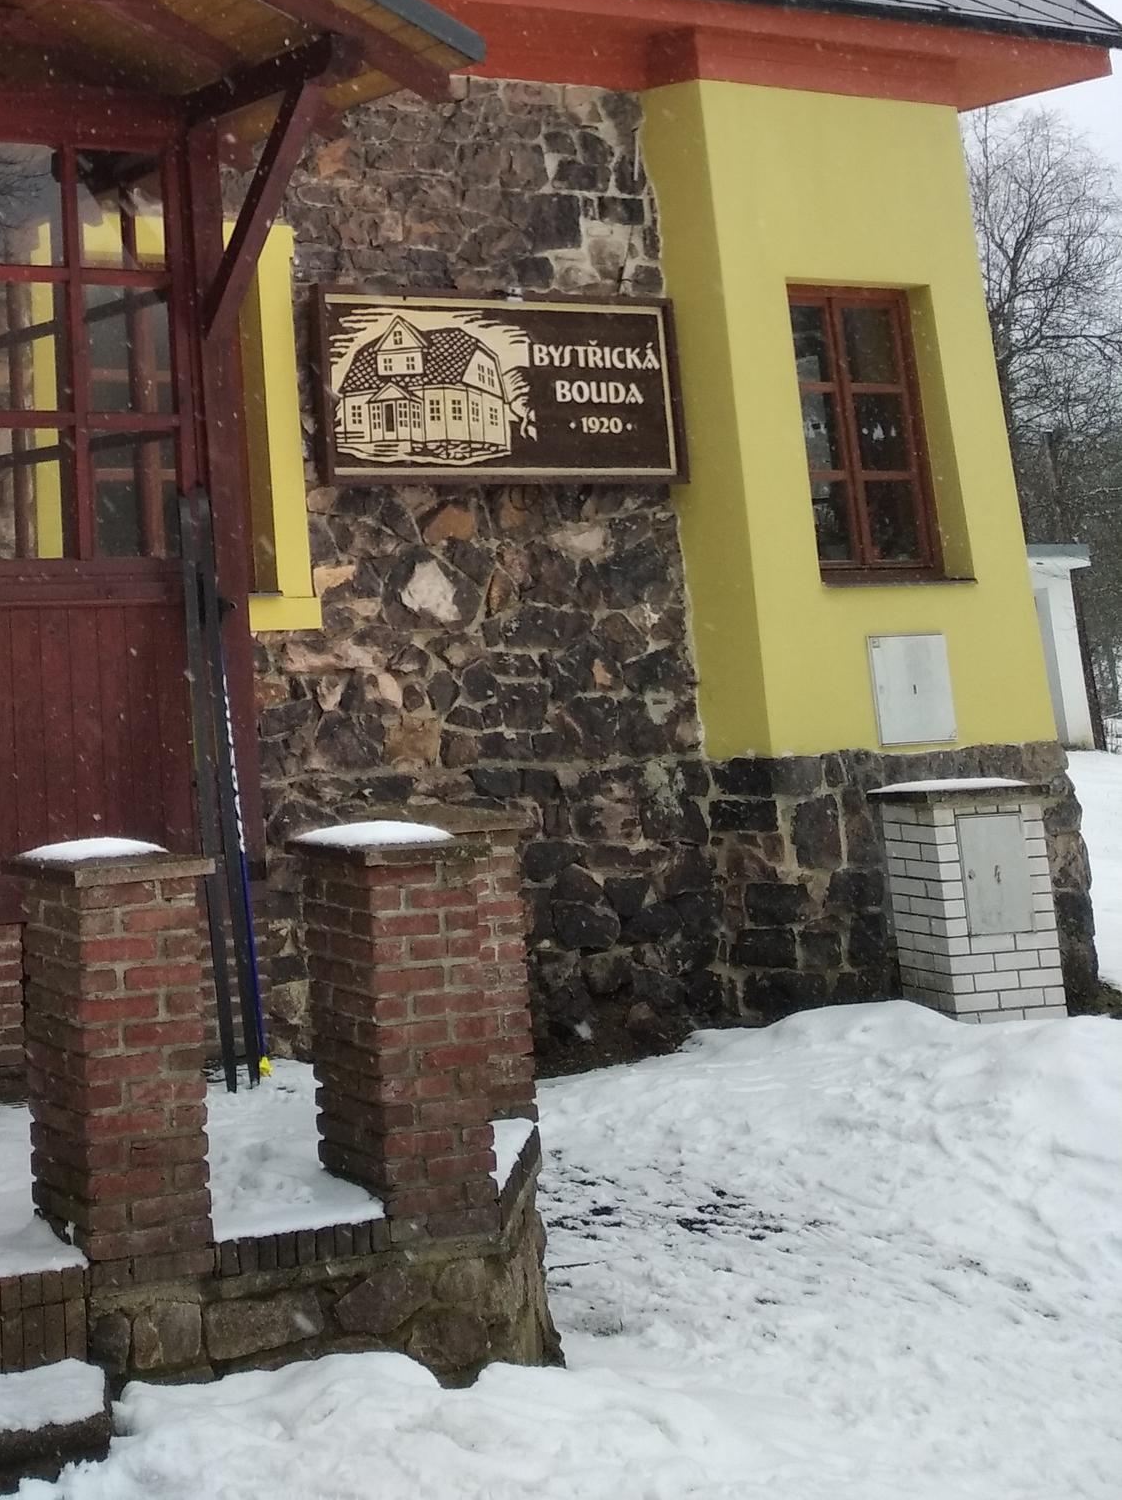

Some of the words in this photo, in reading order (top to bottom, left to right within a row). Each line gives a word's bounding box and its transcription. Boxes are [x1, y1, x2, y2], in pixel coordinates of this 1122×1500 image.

[532, 339, 661, 370] BYSTŘICKÁ
[555, 380, 644, 405] BOUDA
[581, 417, 623, 434] 1920
